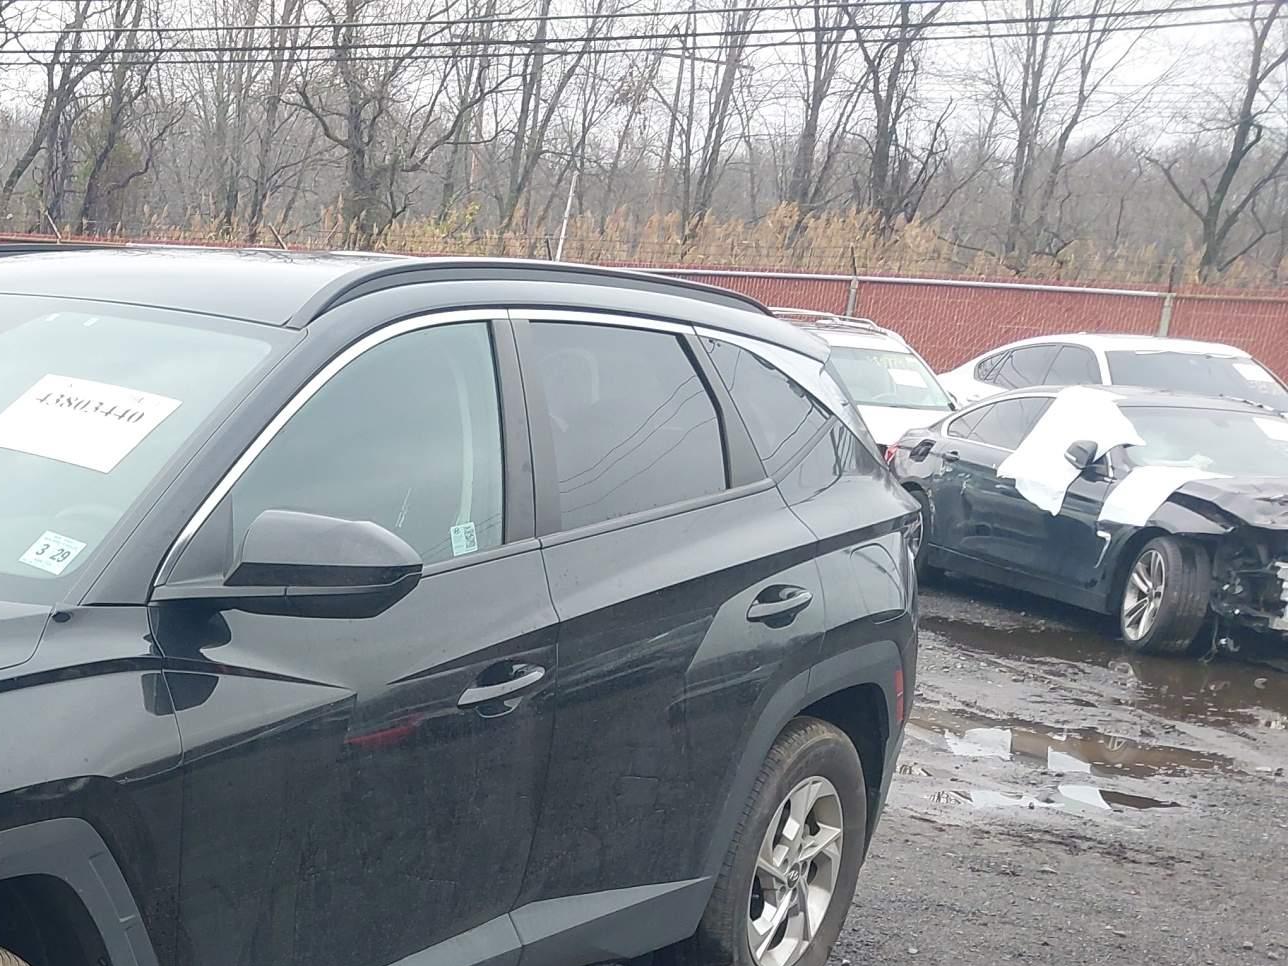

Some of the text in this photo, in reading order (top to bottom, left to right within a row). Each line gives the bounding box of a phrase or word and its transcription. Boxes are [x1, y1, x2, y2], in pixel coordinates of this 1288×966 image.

[36, 393, 145, 423] 43803440
[35, 543, 50, 556] 3
[49, 548, 71, 562] 29
